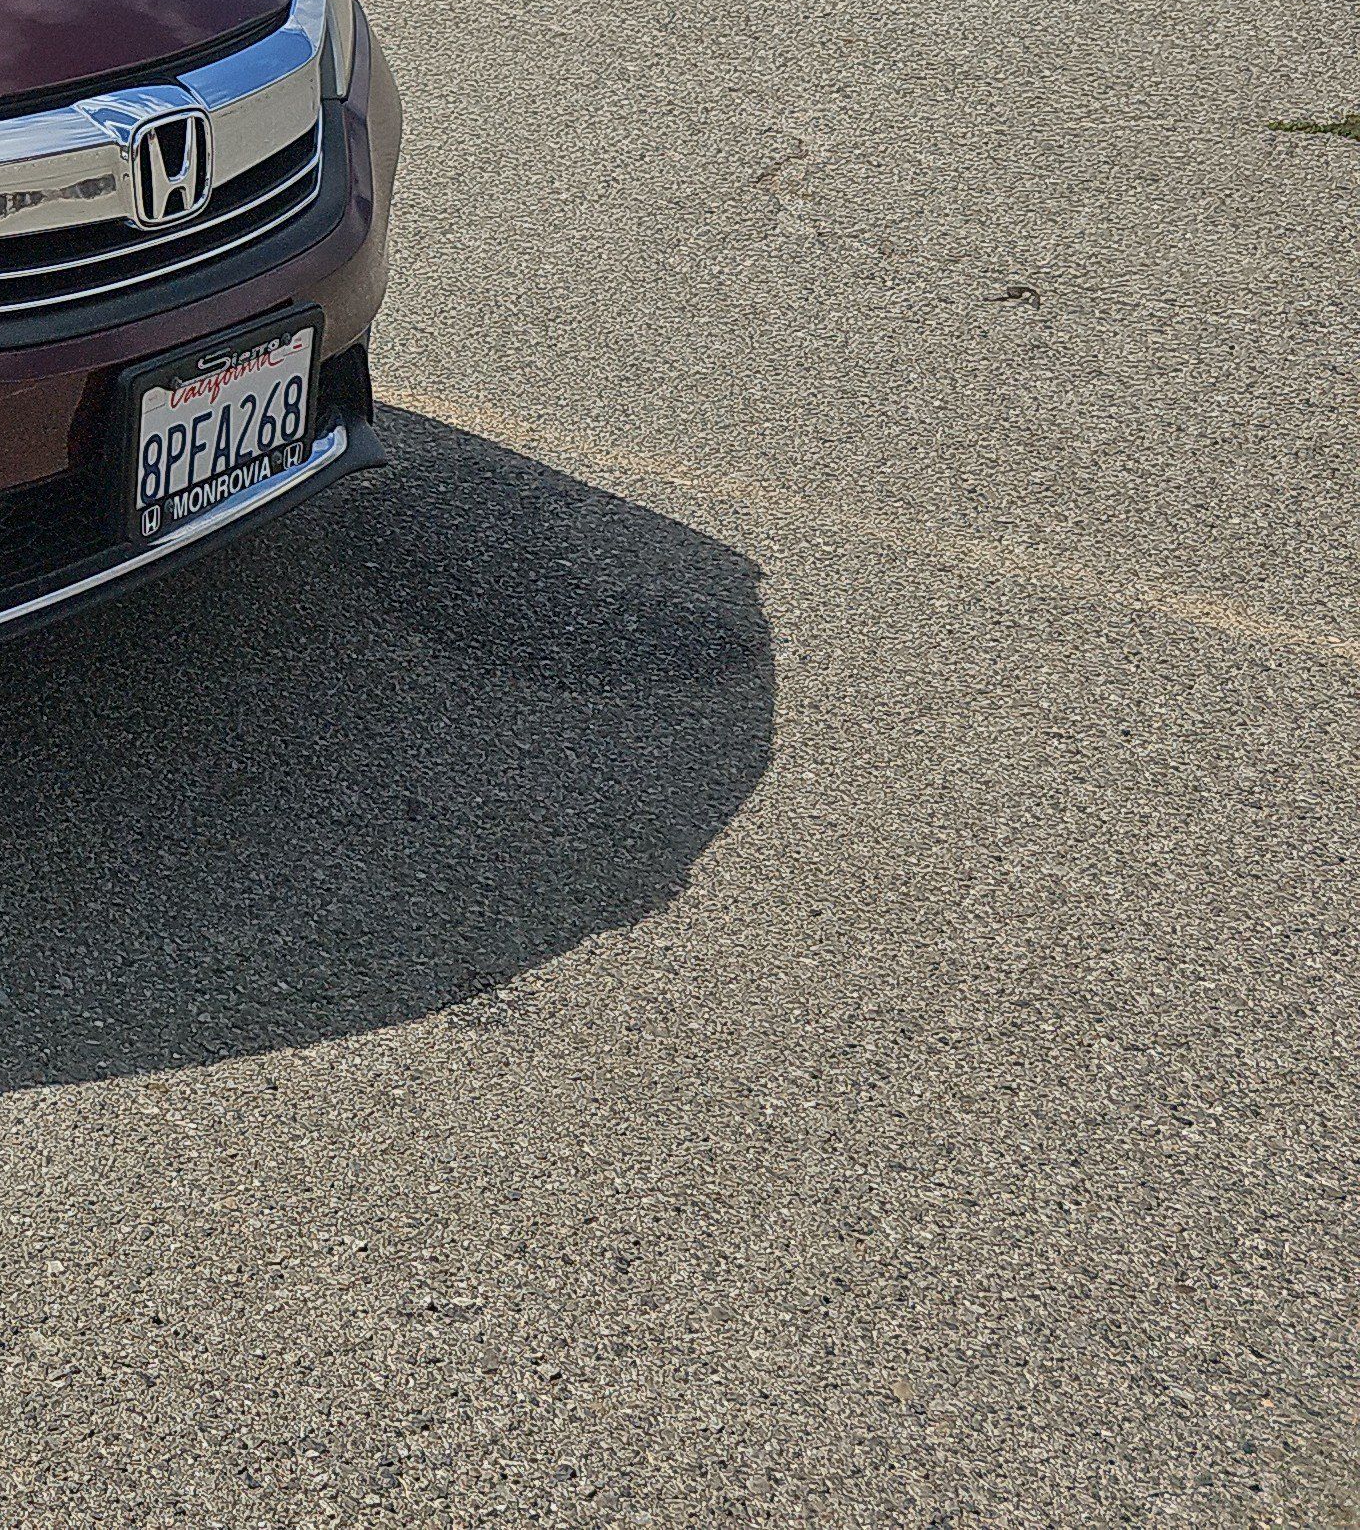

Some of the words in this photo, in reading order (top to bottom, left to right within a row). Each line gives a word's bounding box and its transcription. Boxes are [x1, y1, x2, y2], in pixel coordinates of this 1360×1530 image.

[170, 352, 285, 409] California
[140, 375, 303, 506] 8PFA268
[173, 456, 271, 520] MONROVIA
